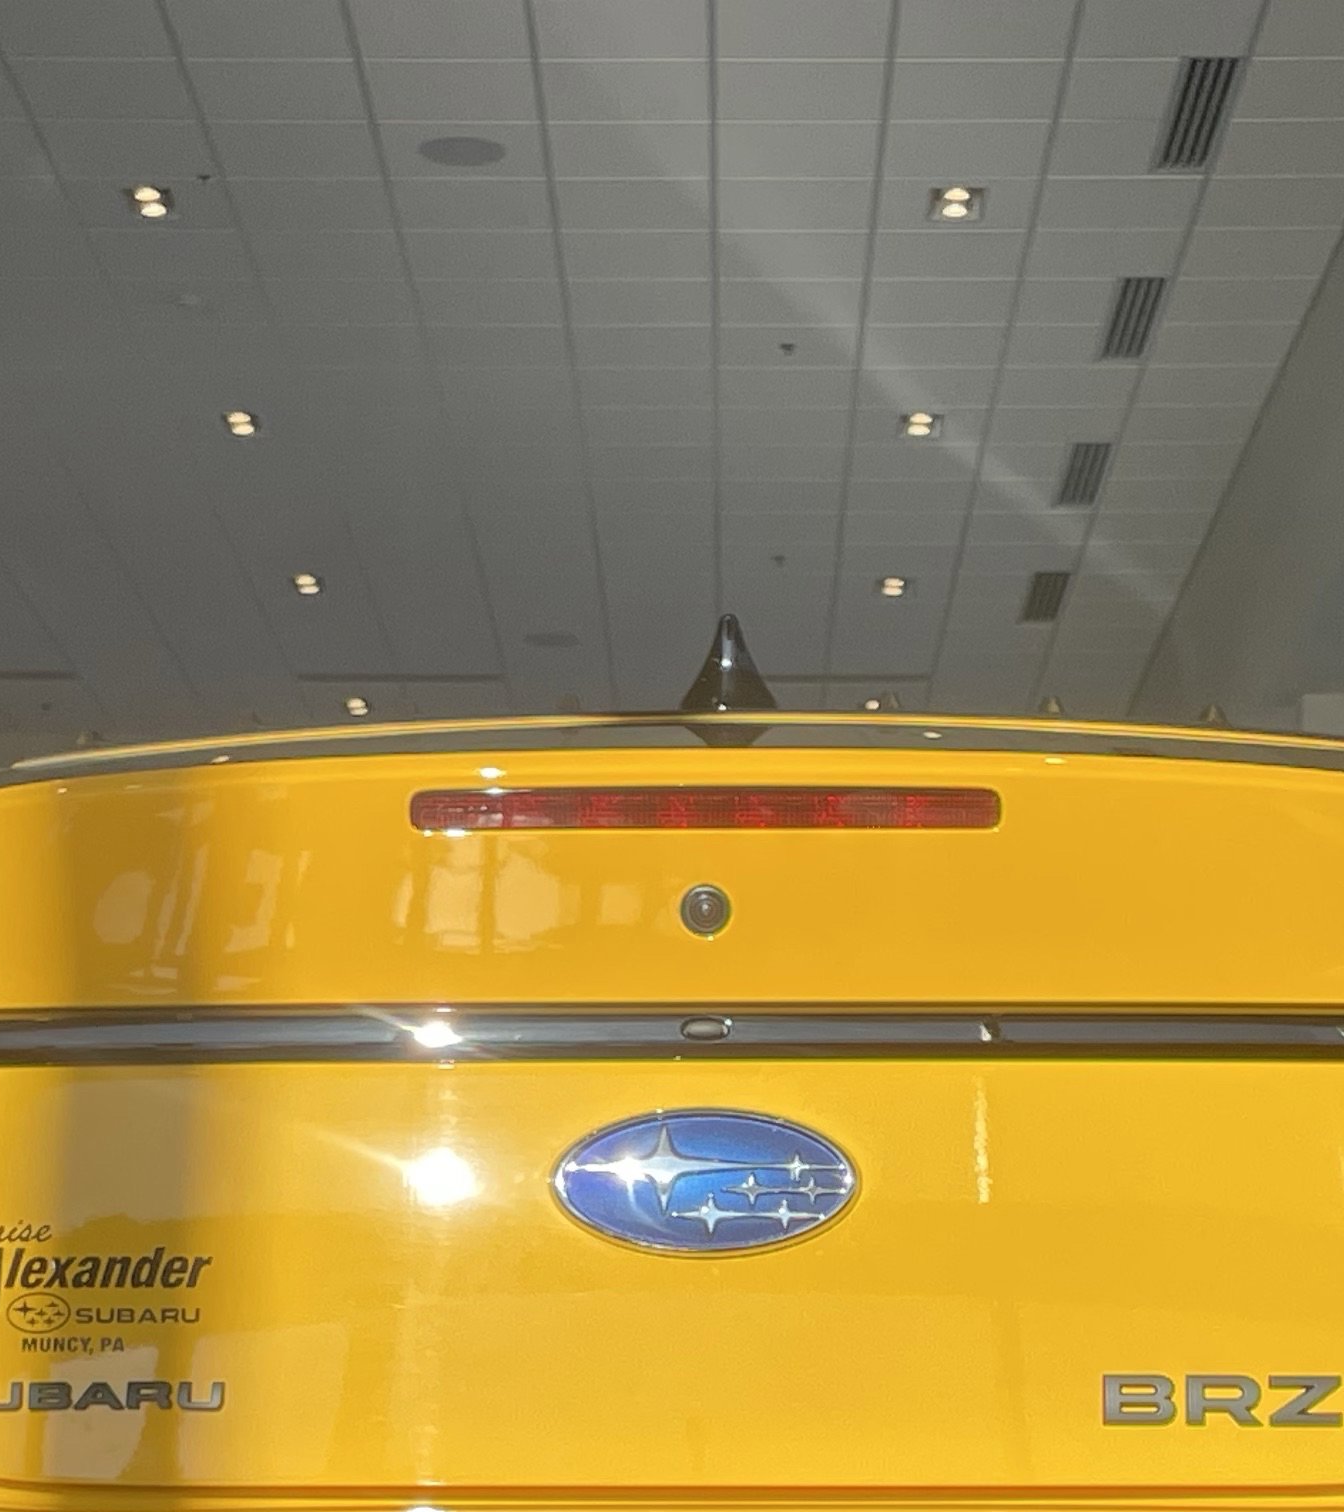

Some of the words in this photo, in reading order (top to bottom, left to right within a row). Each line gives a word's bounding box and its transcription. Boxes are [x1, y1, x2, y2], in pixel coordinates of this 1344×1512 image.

[75, 1307, 201, 1325] SUBARU
[21, 1336, 94, 1355] MUNCY,
[100, 1337, 125, 1353] PA
